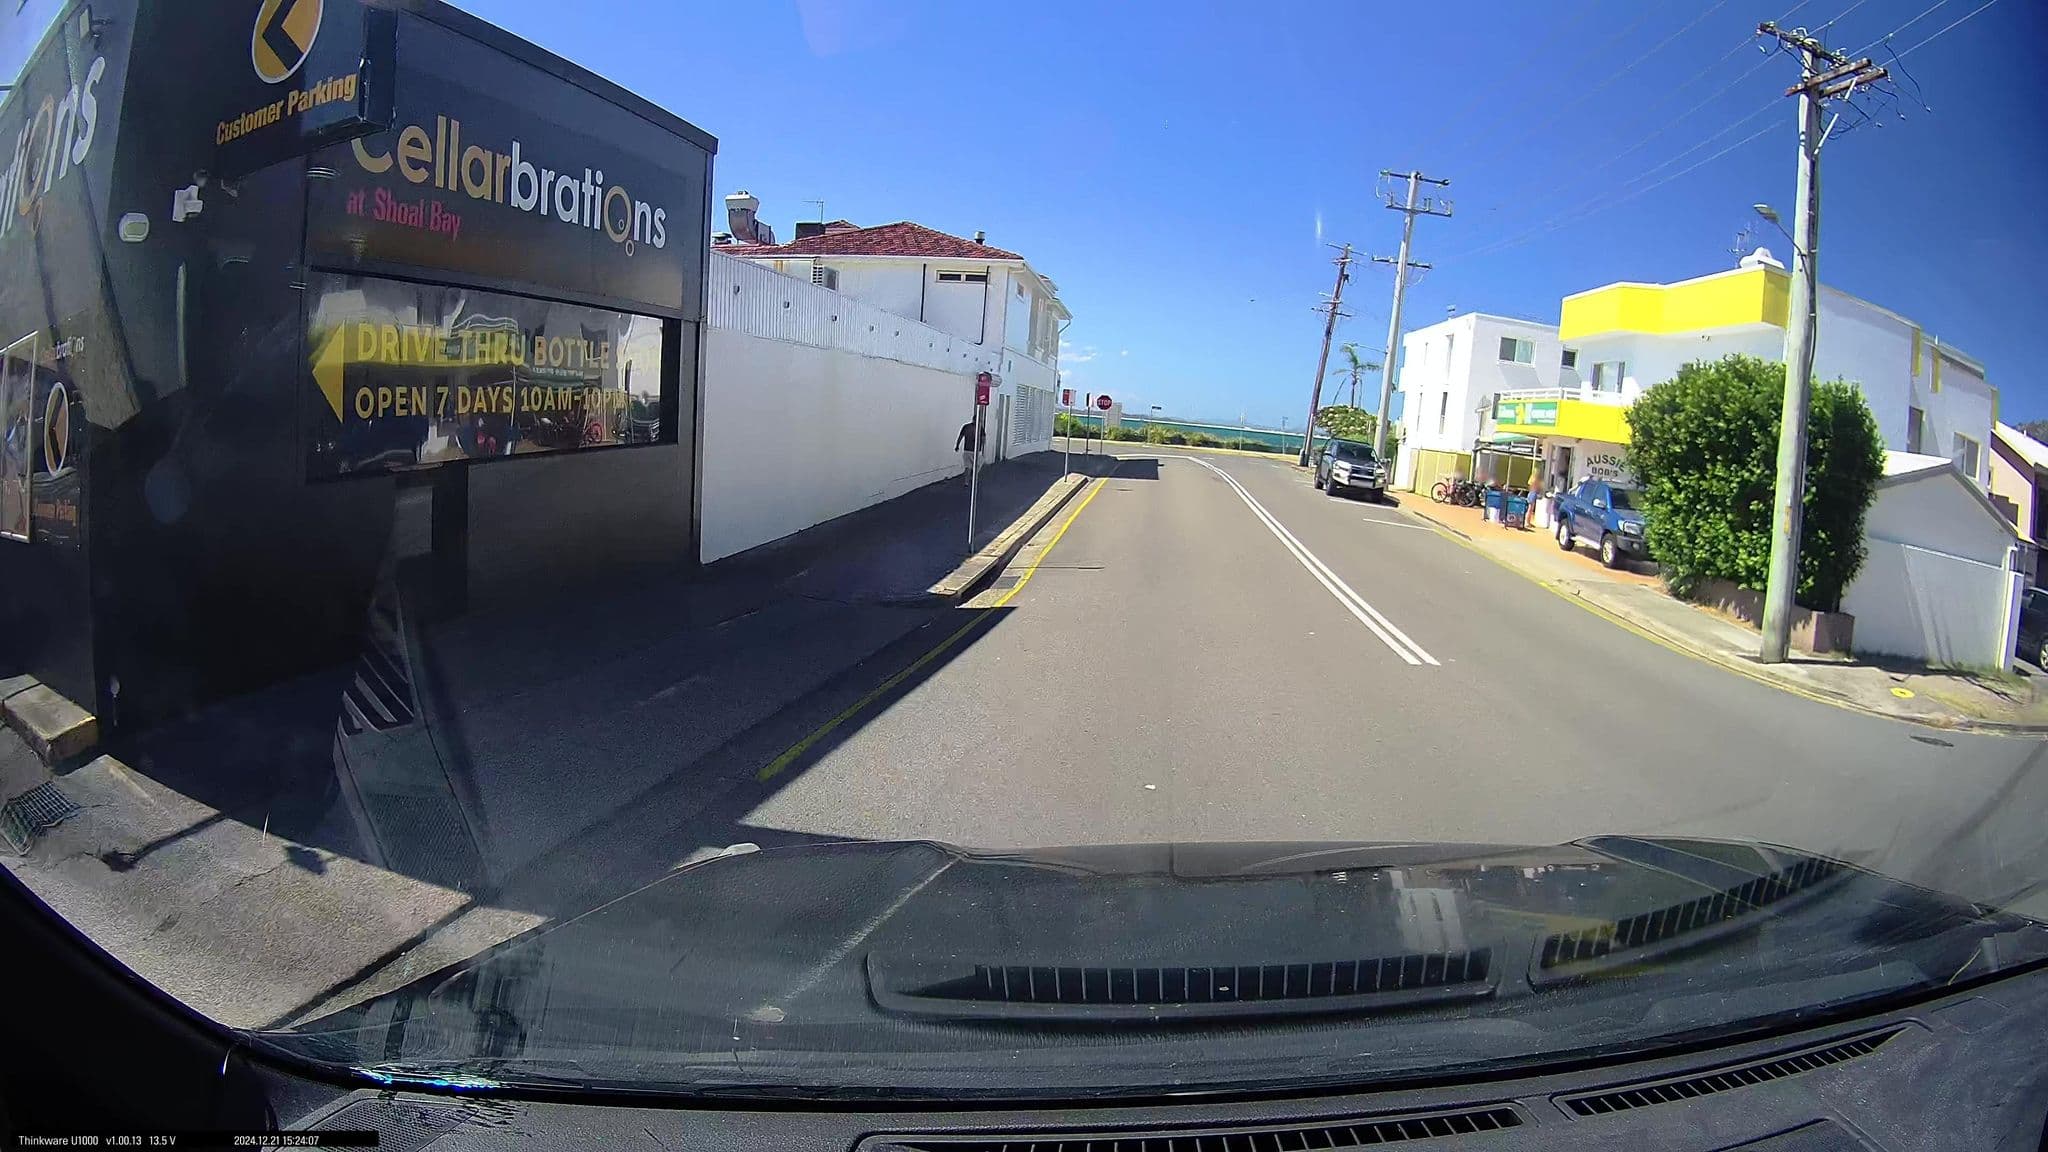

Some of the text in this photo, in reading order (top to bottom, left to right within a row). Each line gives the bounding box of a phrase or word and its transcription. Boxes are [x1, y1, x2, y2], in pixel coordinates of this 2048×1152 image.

[216, 73, 357, 145] Customer Parking
[346, 187, 461, 241] at Shoal Bay
[358, 322, 449, 363] DRIVE
[460, 329, 526, 367] THRU
[534, 335, 610, 370] BOTTLE
[355, 385, 427, 419] OPEN
[436, 386, 449, 417] 7
[457, 385, 514, 415] DAYS
[1586, 454, 1625, 473] AUSSIE
